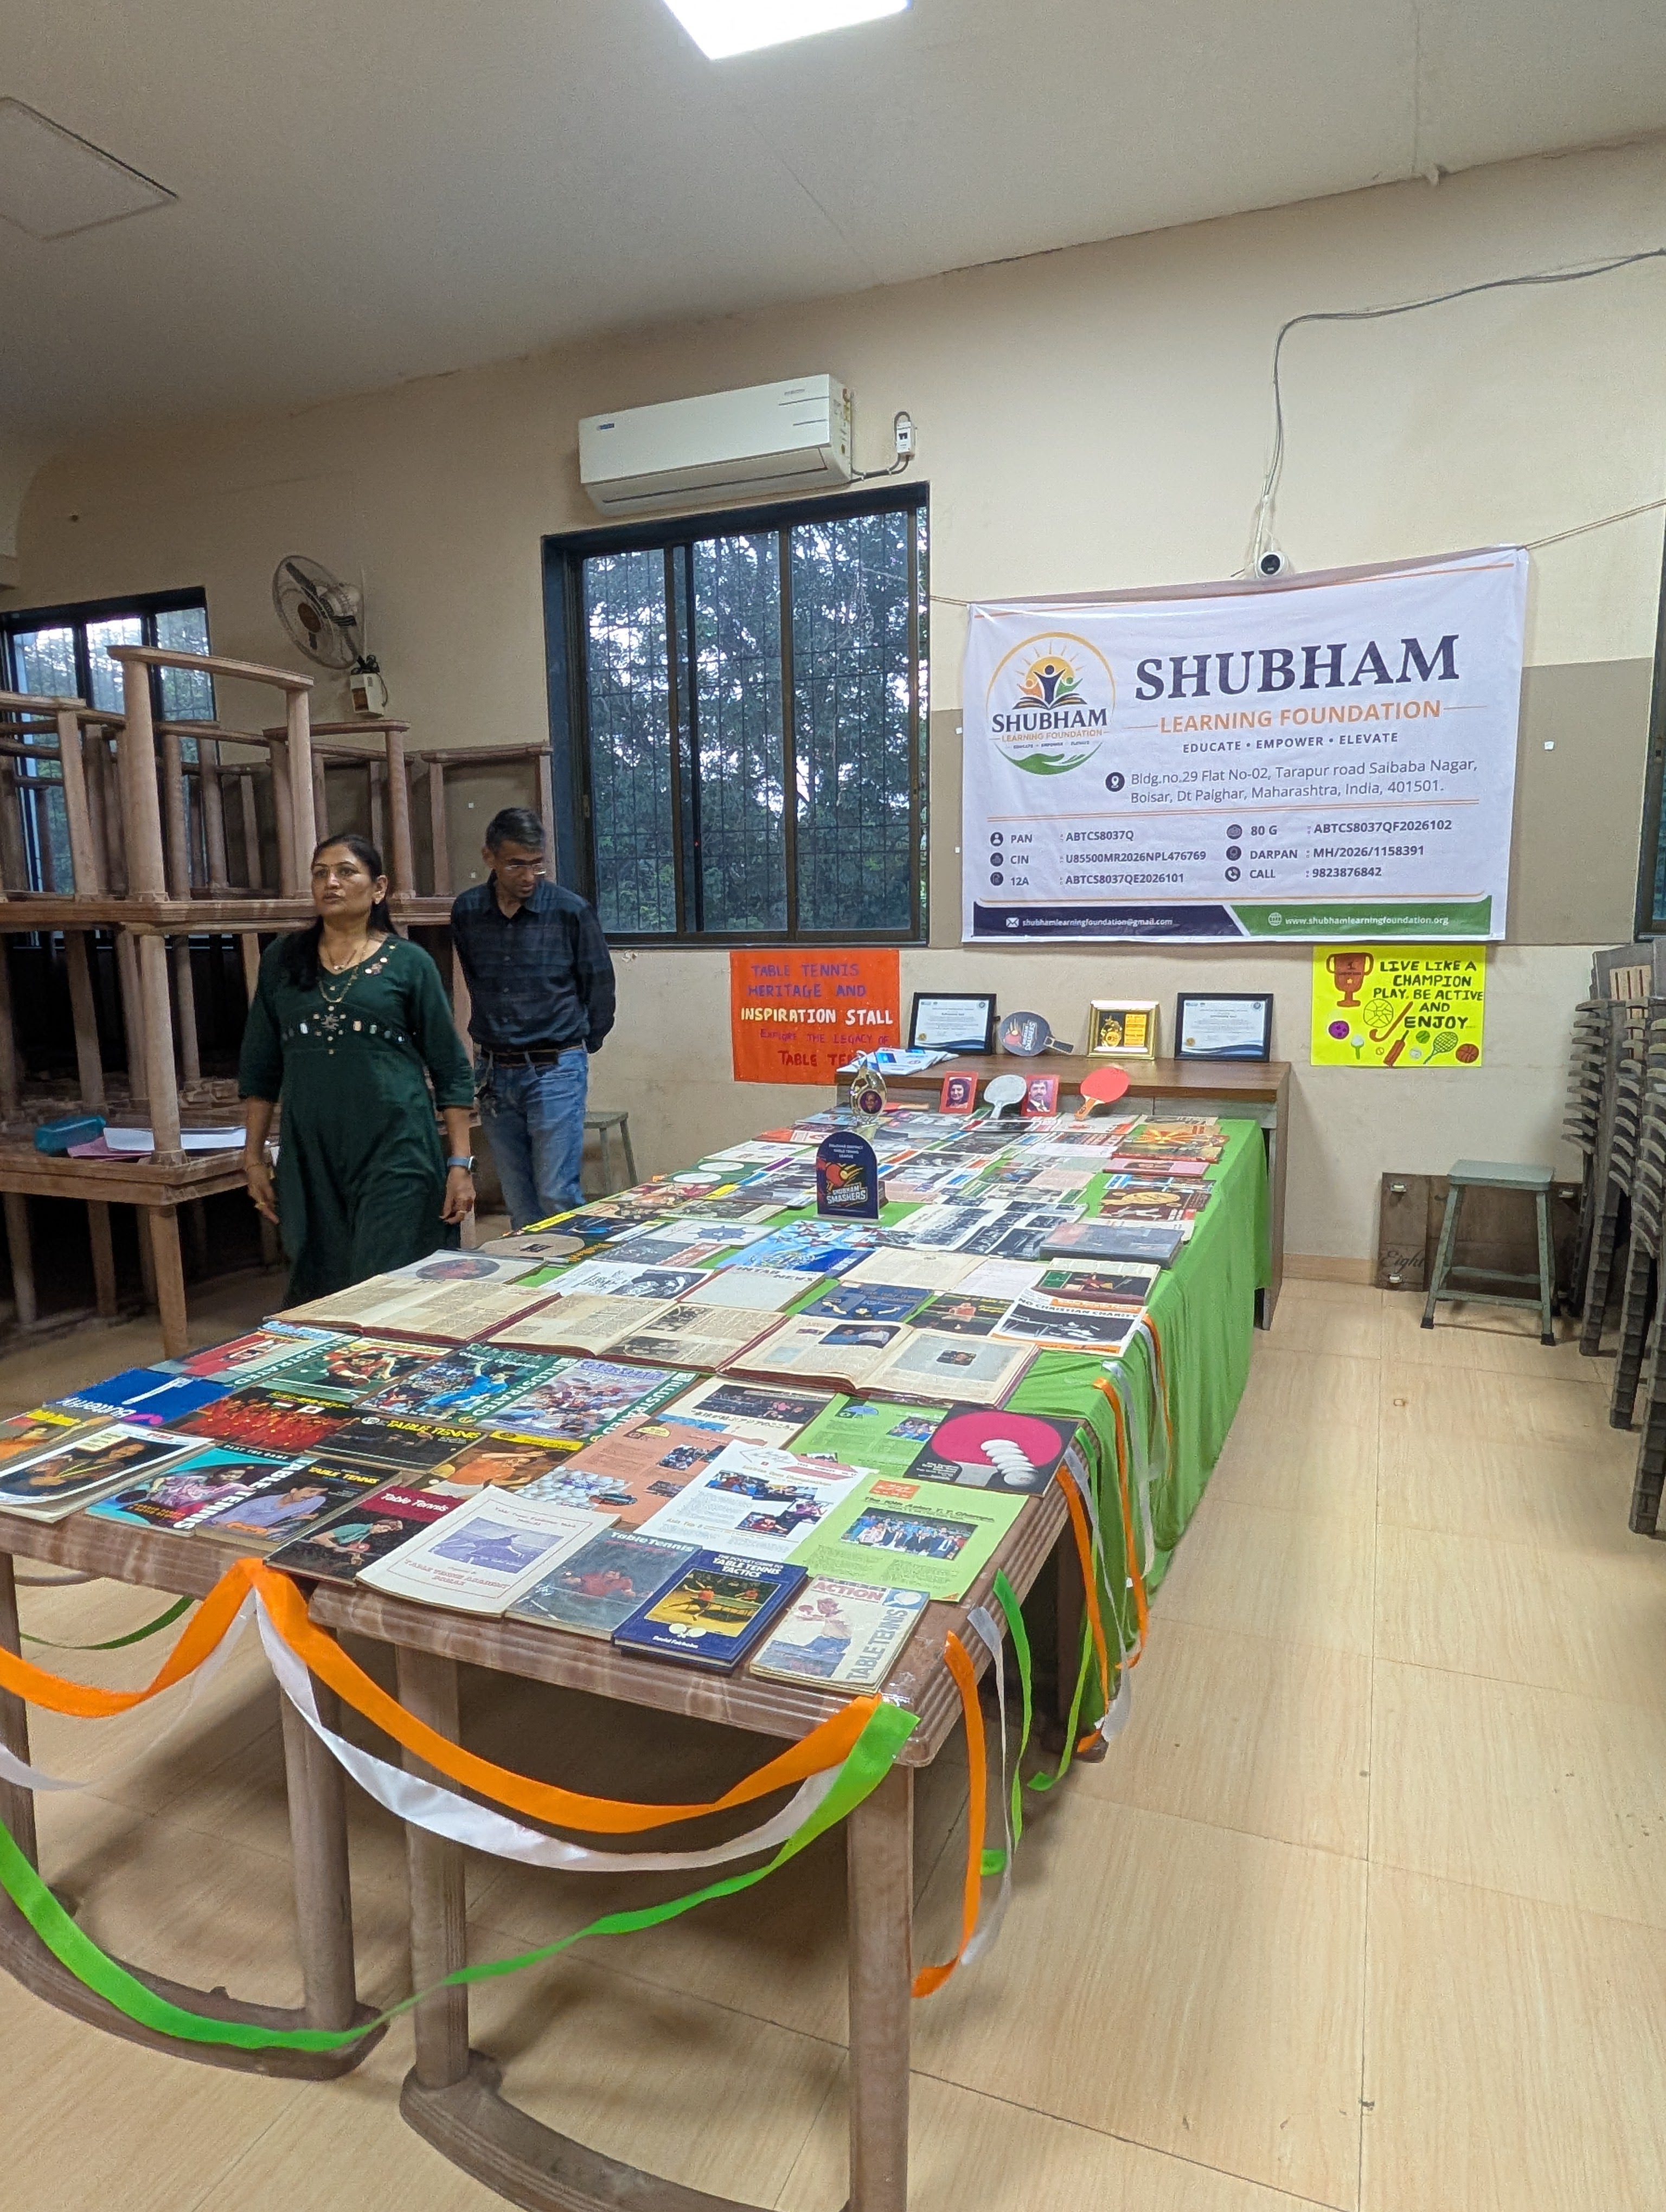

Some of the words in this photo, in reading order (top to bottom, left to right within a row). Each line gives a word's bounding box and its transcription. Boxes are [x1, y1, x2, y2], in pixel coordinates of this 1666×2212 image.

[1135, 634, 1459, 700] SHUBHAM
[991, 708, 1107, 732] SHUBHAM
[1160, 710, 1272, 734] LEARNING
[1280, 700, 1440, 726] FOUNDATION
[1002, 732, 1043, 742] LEARNING
[1046, 729, 1103, 740] FOUNDATION
[1183, 741, 1241, 753] EDUCATE
[1256, 737, 1323, 749] EMPOWER
[1339, 732, 1398, 744] ELEVATE
[1131, 771, 1197, 787] Bldg.no.29
[1202, 770, 1225, 782] Flat
[1229, 768, 1271, 780] No-02,
[1276, 766, 1329, 780] Tarapur
[1333, 762, 1365, 776] road
[1369, 761, 1425, 774] Saibaba
[1430, 760, 1477, 774] Nagar,
[1131, 792, 1173, 803] Boisar,
[1177, 790, 1191, 801] Dt
[1195, 788, 1247, 803] Palghar,
[1251, 785, 1341, 799] Maharashtra,
[1345, 782, 1382, 795] India,
[1387, 780, 1444, 793] 401501.
[1251, 826, 1265, 835] 80
[1269, 825, 1278, 835] G
[1313, 820, 1452, 834] ABTCS8037QF2026102
[1010, 834, 1033, 843] PAN
[1065, 831, 1134, 842] ABTCS8037Q
[1010, 856, 1029, 865] CIN
[1250, 849, 1298, 860] DARPAN
[1313, 845, 1424, 858] MH/2026/1158391
[1010, 877, 1029, 886] 12A
[1065, 873, 1184, 885] ABTCS8037QE2026101
[1250, 870, 1276, 879] CALL
[1312, 867, 1382, 878] 9823876842
[1285, 915, 1449, 925] www.shubhamlearningfoundation.org
[751, 964, 791, 976] TABLE
[802, 963, 860, 976] TENNIS
[1380, 960, 1419, 972] LIVE
[1425, 960, 1461, 972] LIKE
[1465, 961, 1477, 971] A
[1393, 974, 1471, 987] CHAMPION
[747, 983, 822, 998] HERITAGE
[836, 985, 866, 997] AND
[1413, 989, 1431, 1000] BE
[1434, 989, 1484, 1001] ACTIVE
[1419, 1002, 1450, 1013] AND
[740, 1007, 836, 1024] INSPIRATION
[845, 1008, 893, 1026] STALL
[806, 1033, 825, 1043] THE
[878, 1036, 889, 1045] OF
[826, 1189, 866, 1205] SMASHERS
[1018, 1297, 1033, 1306] NO
[234, 1341, 343, 1385] ILLUSTRATED
[472, 1365, 564, 1416] ILLUSTRATED
[387, 1419, 432, 1432] TABLE
[431, 1426, 482, 1439] TENNIS
[248, 1456, 321, 1489] TABLE
[307, 1466, 341, 1477] TABLE
[342, 1473, 380, 1484] TENNIS
[173, 1491, 257, 1529] TENNIS
[381, 1493, 412, 1504] Table
[411, 1499, 449, 1512] Tennis
[611, 1532, 649, 1544] Table
[649, 1538, 695, 1553] Tennis
[713, 1558, 745, 1568] TABLE
[745, 1563, 782, 1575] TENNIS
[730, 1555, 754, 1564] POCKET
[721, 1566, 762, 1578] TACTICS
[813, 1581, 885, 1601] ACTION
[845, 1646, 886, 1680] TABLE
[867, 1609, 908, 1645] TENNIS
